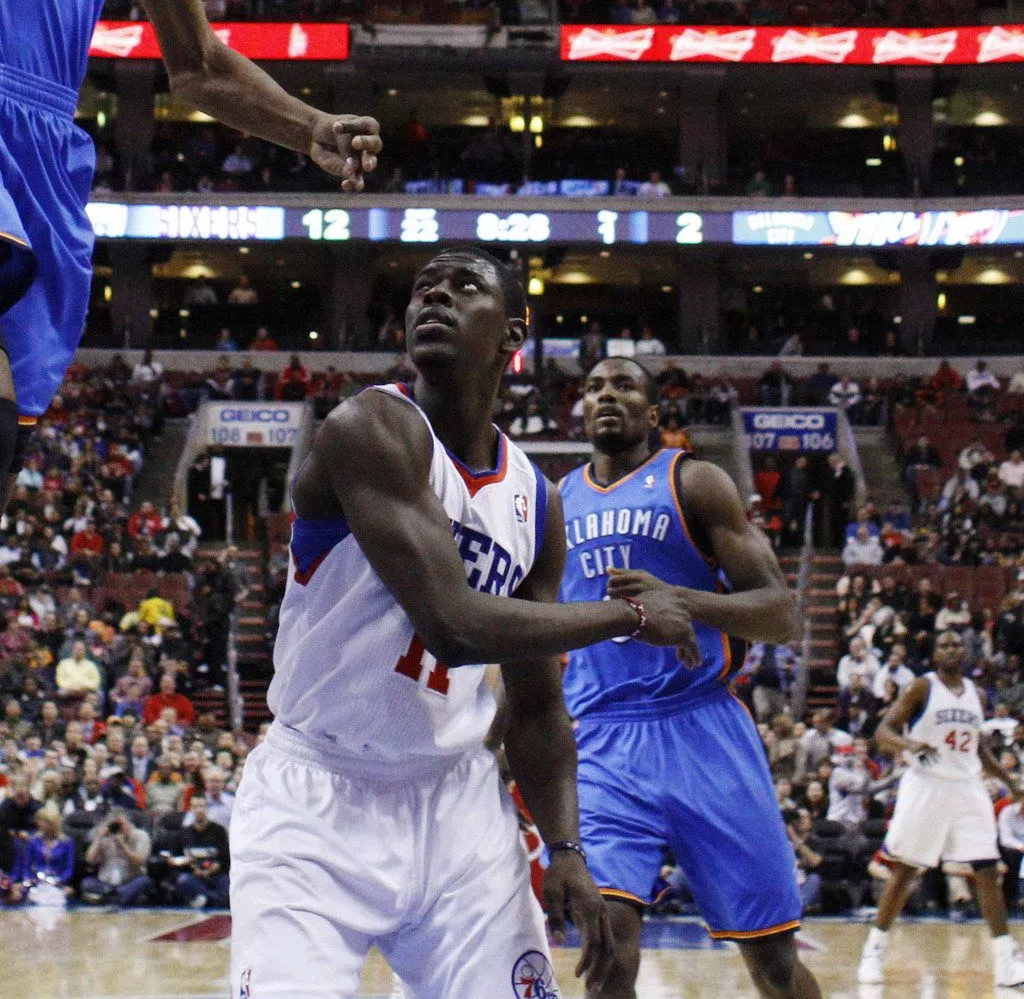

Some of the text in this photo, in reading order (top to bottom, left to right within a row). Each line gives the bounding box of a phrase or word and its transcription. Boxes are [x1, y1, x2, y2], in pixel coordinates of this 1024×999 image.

[303, 209, 347, 240] 12
[219, 409, 290, 423] GEICO
[753, 414, 825, 430] GEICO
[580, 544, 631, 579] CITY
[944, 729, 973, 752] 42
